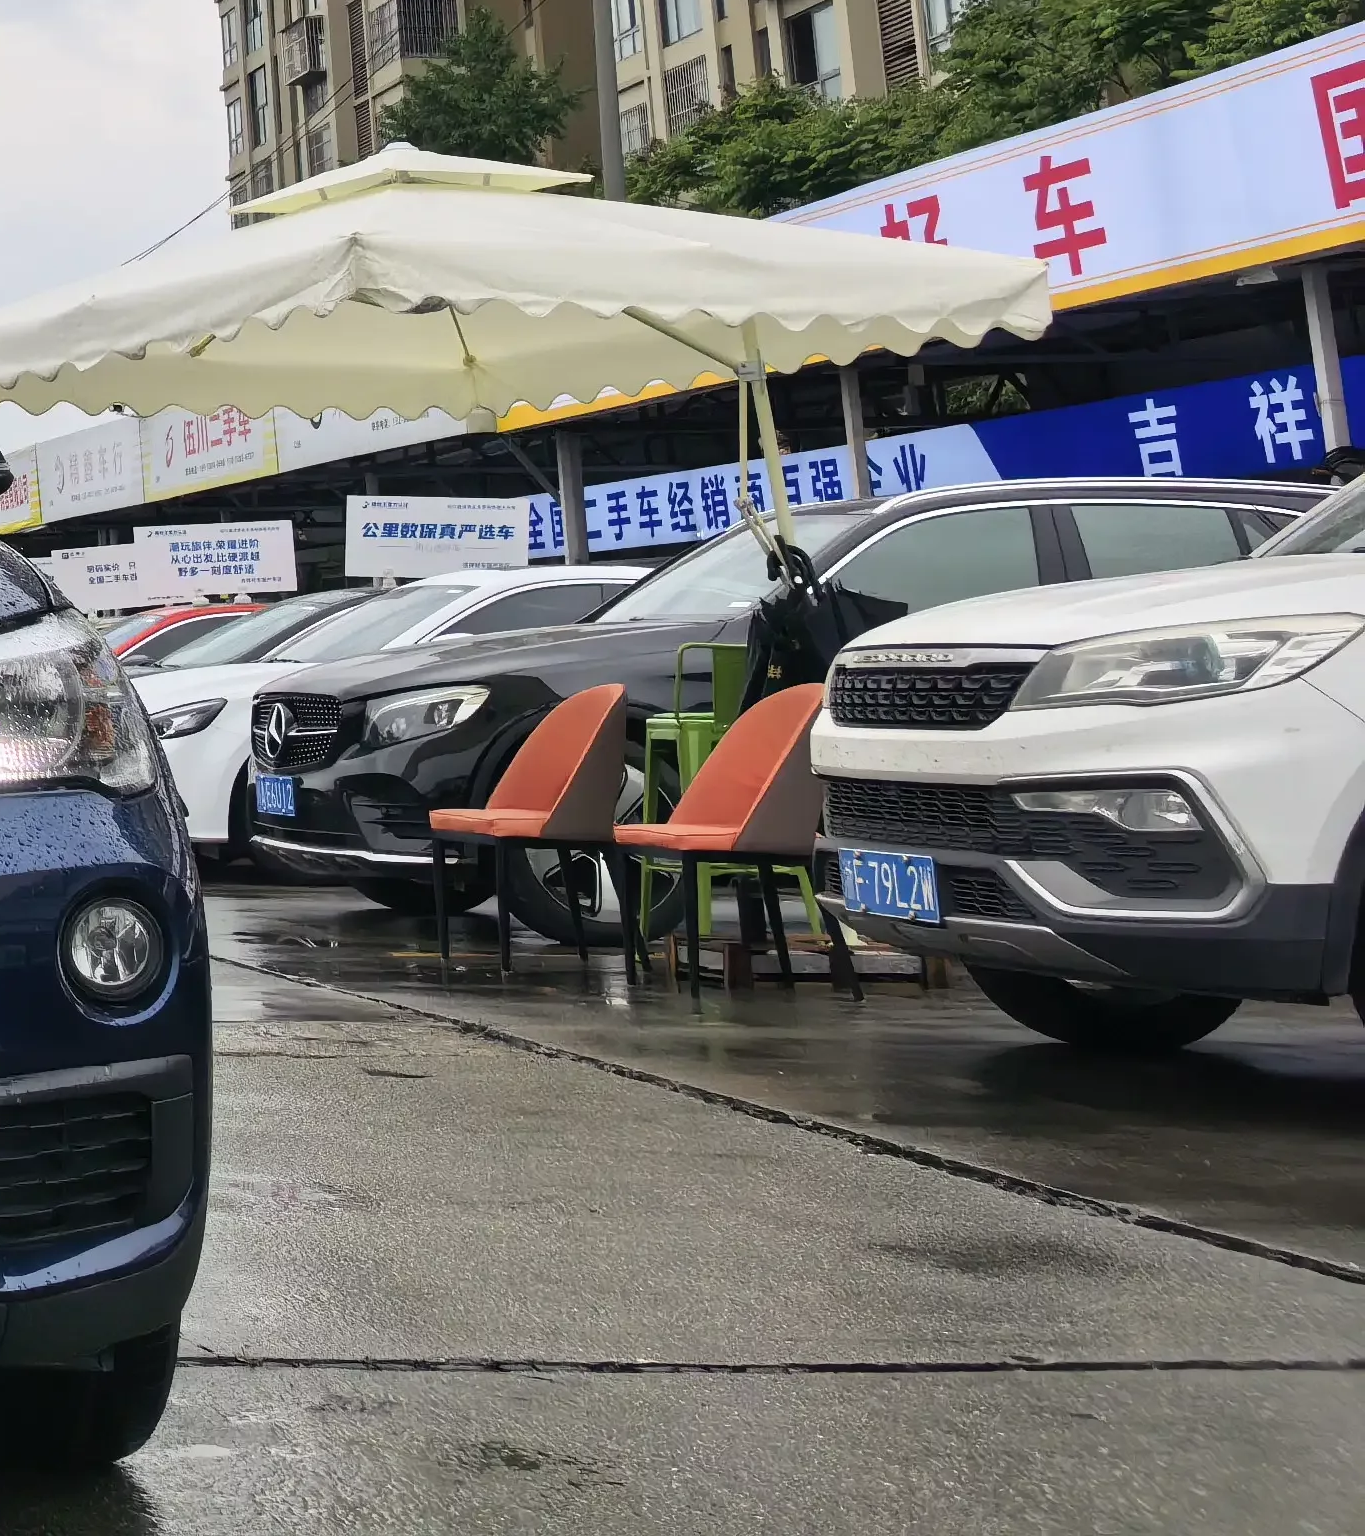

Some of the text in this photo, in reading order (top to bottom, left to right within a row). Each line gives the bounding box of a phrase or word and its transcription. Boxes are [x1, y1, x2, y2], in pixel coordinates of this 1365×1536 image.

[1127, 374, 1315, 478] 吉祥
[361, 522, 516, 540] 公里数保真严选车
[170, 551, 261, 565] 从心出发,比硬派越
[177, 564, 255, 577] 野多一刻度舒适
